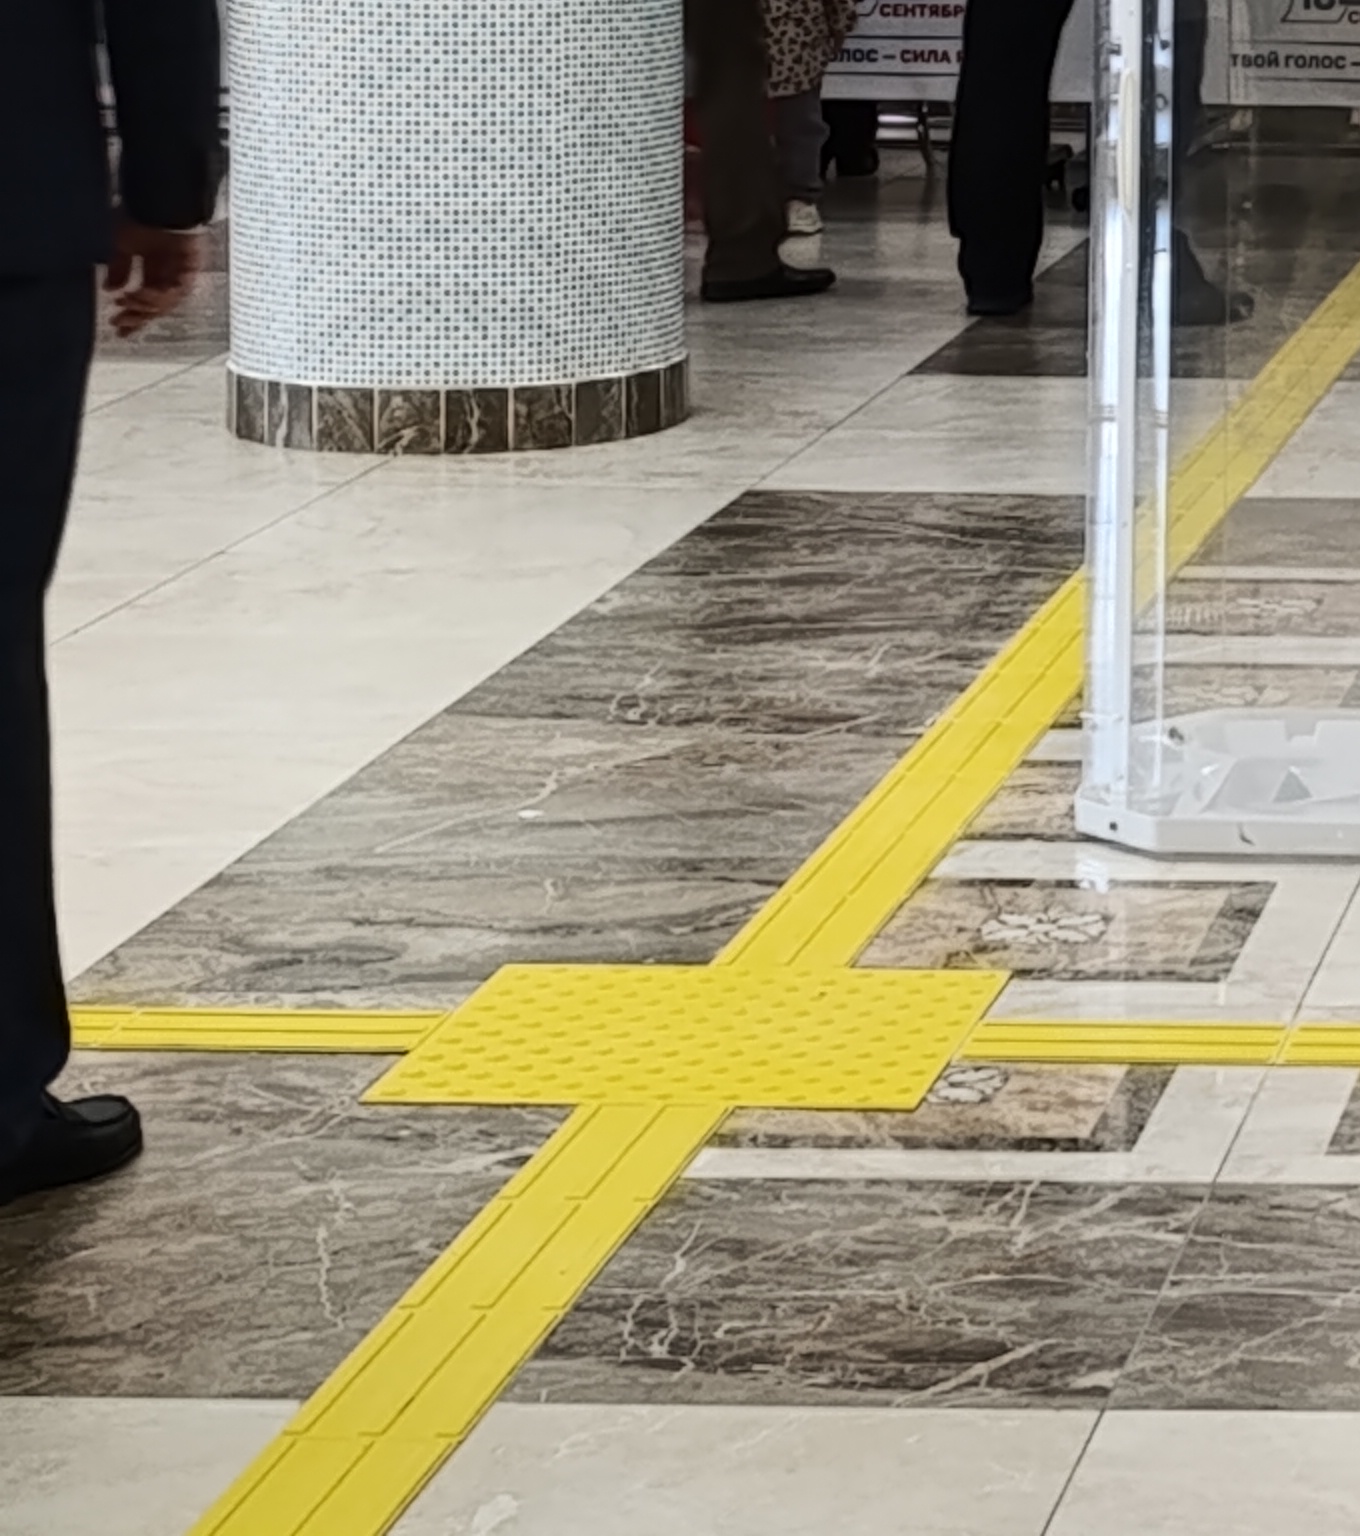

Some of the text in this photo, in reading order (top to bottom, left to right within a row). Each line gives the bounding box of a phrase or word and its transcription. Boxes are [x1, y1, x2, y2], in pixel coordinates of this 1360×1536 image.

[900, 48, 952, 65] СИЛА
[1230, 50, 1280, 70] ТВОЙ
[1284, 54, 1347, 71] ГОЛОС
